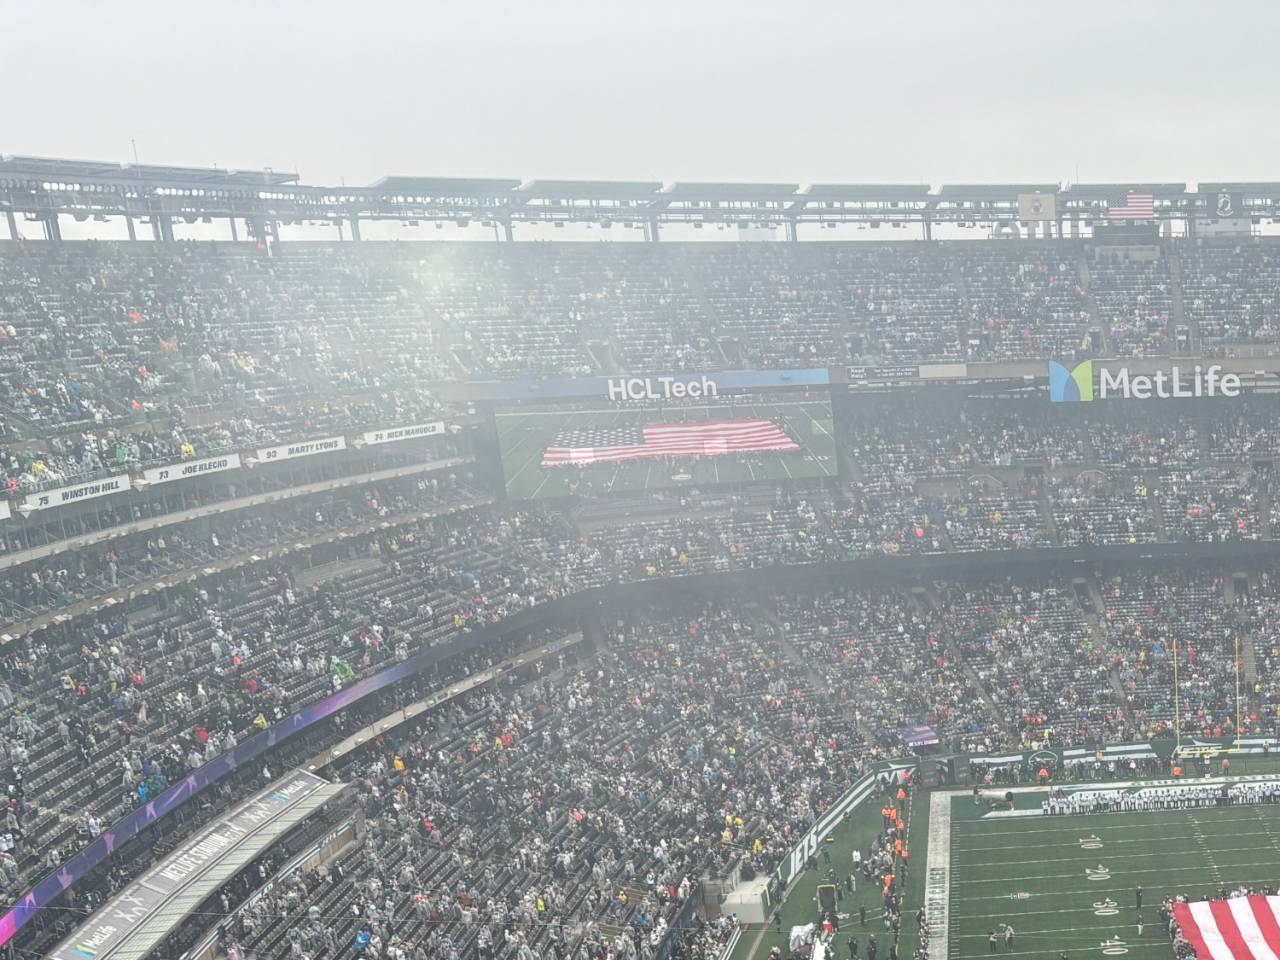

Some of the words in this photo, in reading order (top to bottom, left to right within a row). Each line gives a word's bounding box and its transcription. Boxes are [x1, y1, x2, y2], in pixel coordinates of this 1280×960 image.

[607, 375, 718, 401] HCLTech
[1100, 364, 1241, 400] MetLife
[266, 450, 278, 459] 93
[288, 443, 314, 456] MARTY
[315, 440, 338, 451] LYONS
[159, 470, 169, 480] 73
[182, 464, 198, 475] JOE
[38, 495, 50, 506] 75
[61, 483, 101, 501] WINSTON
[101, 479, 121, 493] HILL
[160, 846, 204, 882] METLIFE
[193, 831, 229, 865] STADIUM
[786, 832, 818, 884] JETS
[1093, 900, 1120, 915] 30
[82, 924, 118, 948] MetLife
[1100, 939, 1129, 955] 40
